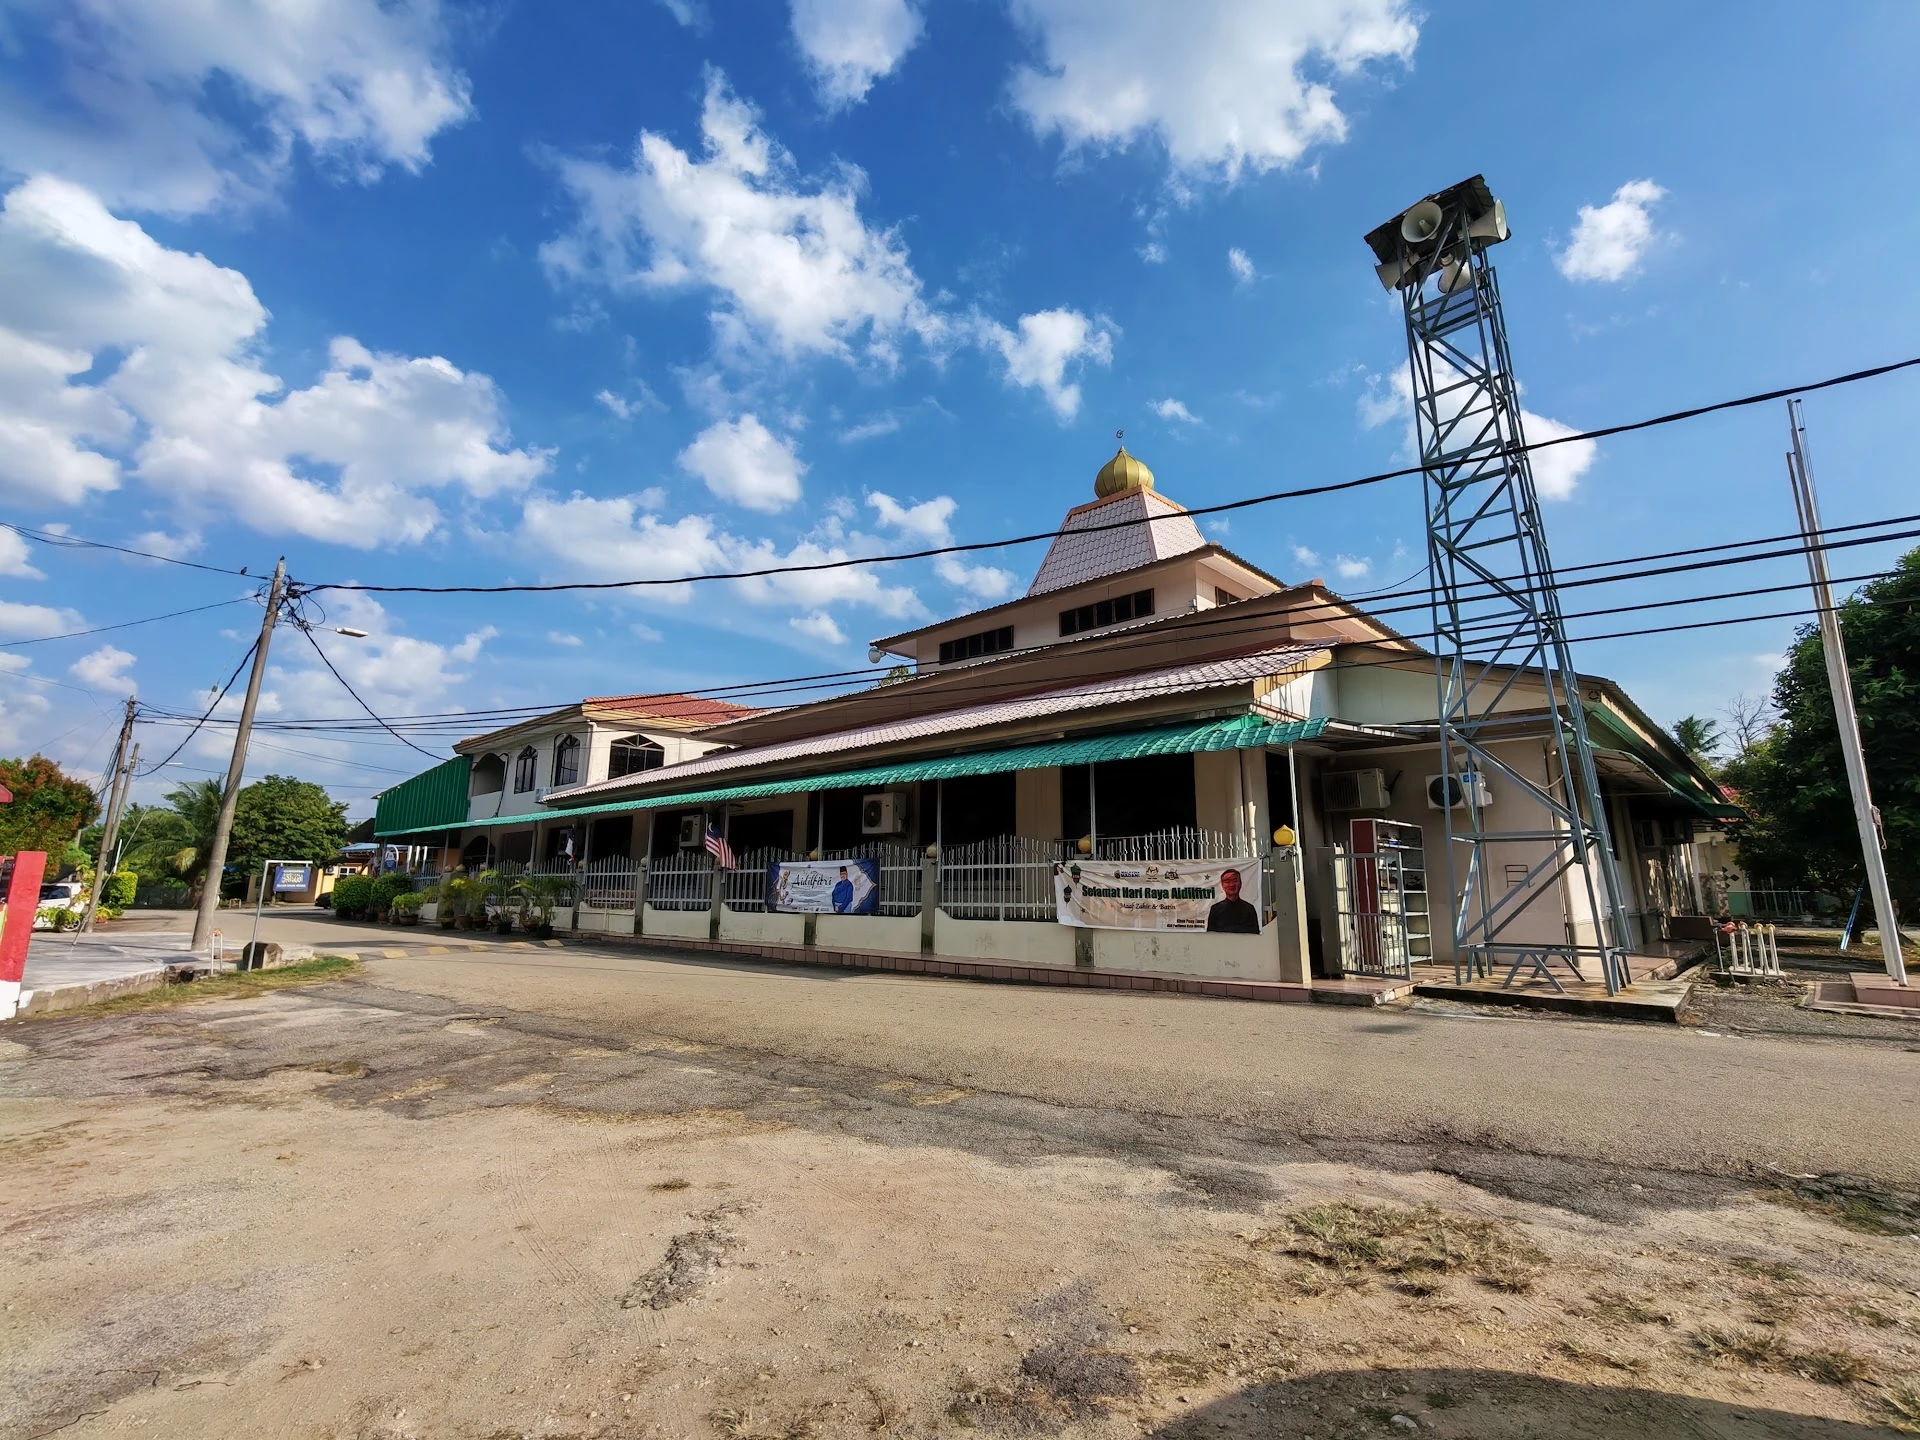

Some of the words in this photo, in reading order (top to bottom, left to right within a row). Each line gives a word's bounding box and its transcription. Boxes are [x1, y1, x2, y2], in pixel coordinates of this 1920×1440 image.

[791, 874, 832, 889] Aidilfitri
[1082, 885, 1121, 898] Selamat
[1122, 887, 1143, 899] Hari
[1144, 887, 1170, 900] Raya
[1171, 887, 1215, 901] Aidilfitri
[1120, 902, 1135, 911] Maaf
